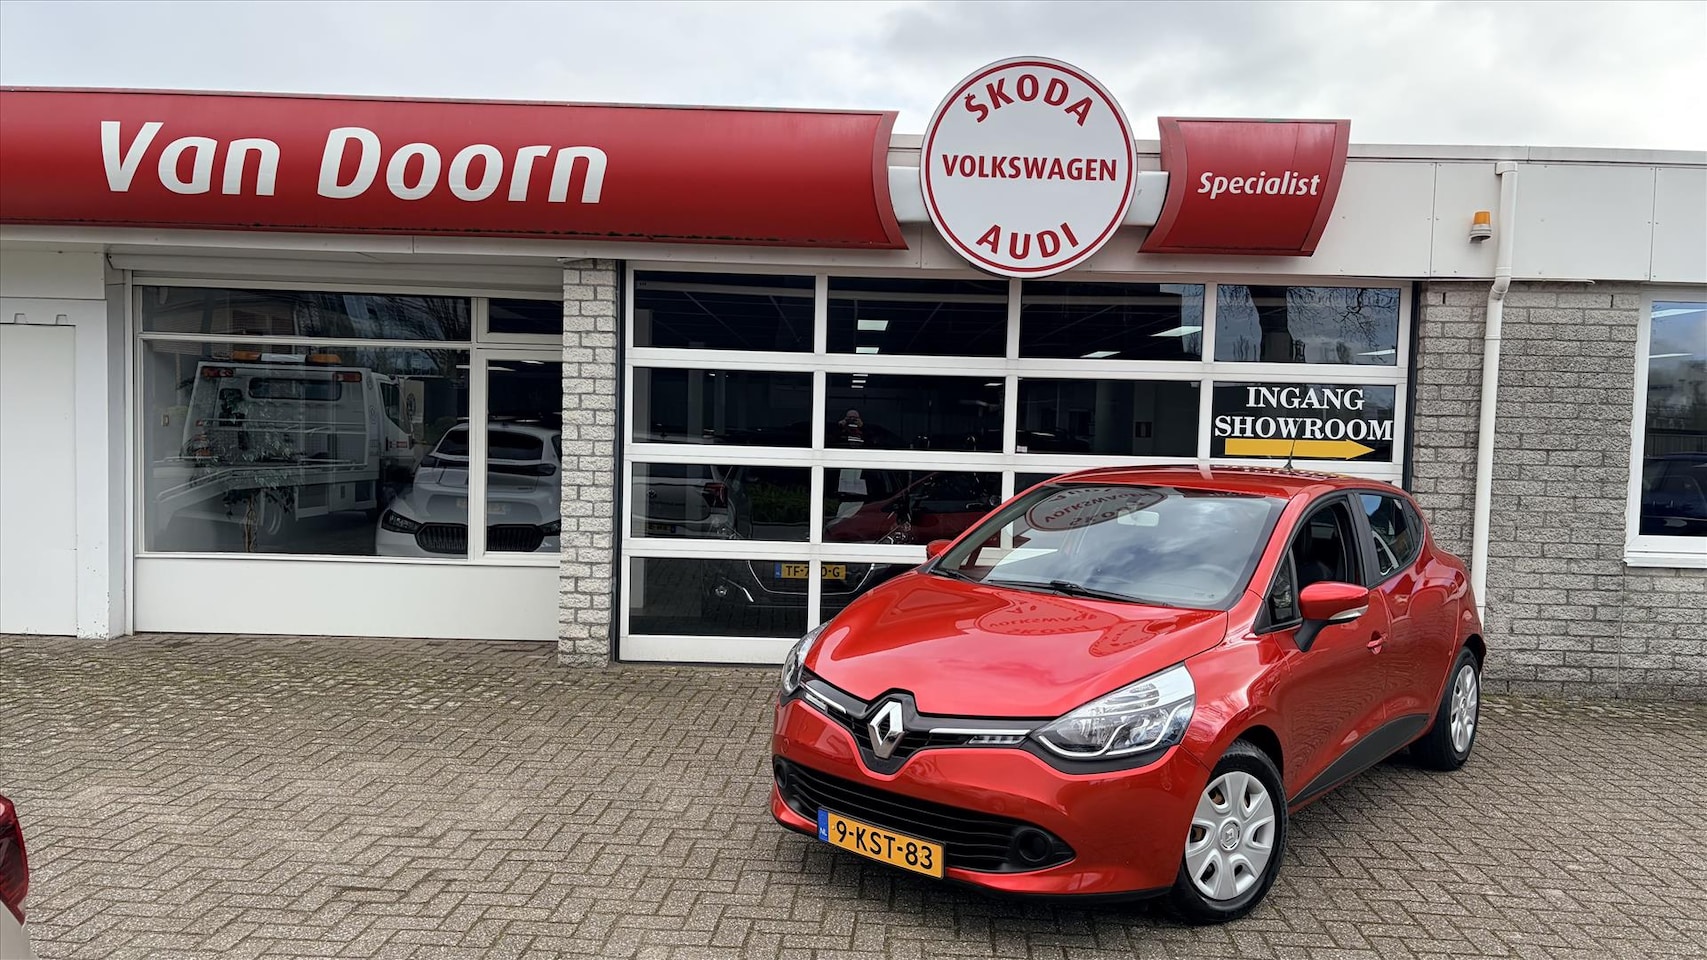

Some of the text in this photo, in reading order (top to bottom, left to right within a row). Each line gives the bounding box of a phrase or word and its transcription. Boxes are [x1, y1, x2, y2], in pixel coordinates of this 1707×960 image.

[964, 74, 1094, 126] ŠKODA
[101, 121, 607, 204] Van Doorn
[942, 154, 1117, 182] VOLKSWAGEN
[1197, 170, 1321, 200] Specialist
[976, 222, 1079, 260] AUDI
[1246, 386, 1365, 411] INGANG
[1214, 415, 1394, 441] SHOWROOM
[836, 820, 933, 870] 9-KST-83
